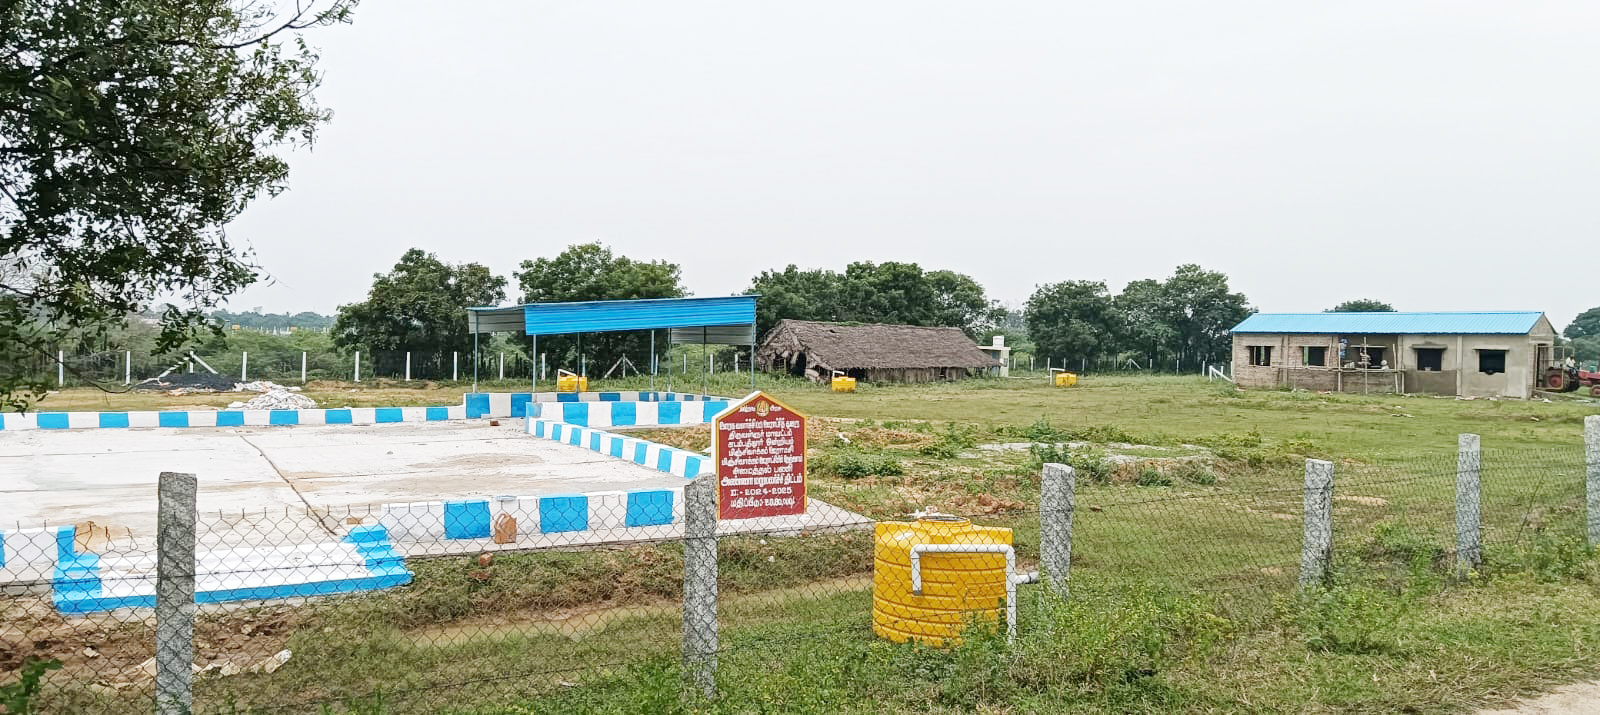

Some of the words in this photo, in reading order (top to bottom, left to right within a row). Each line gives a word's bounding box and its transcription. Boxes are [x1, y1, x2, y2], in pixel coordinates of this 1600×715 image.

[765, 428, 793, 438] மாவட்டம்
[766, 437, 794, 446] ஒன்றியம்
[773, 463, 793, 473] பணி
[721, 474, 753, 486] அண்ணா
